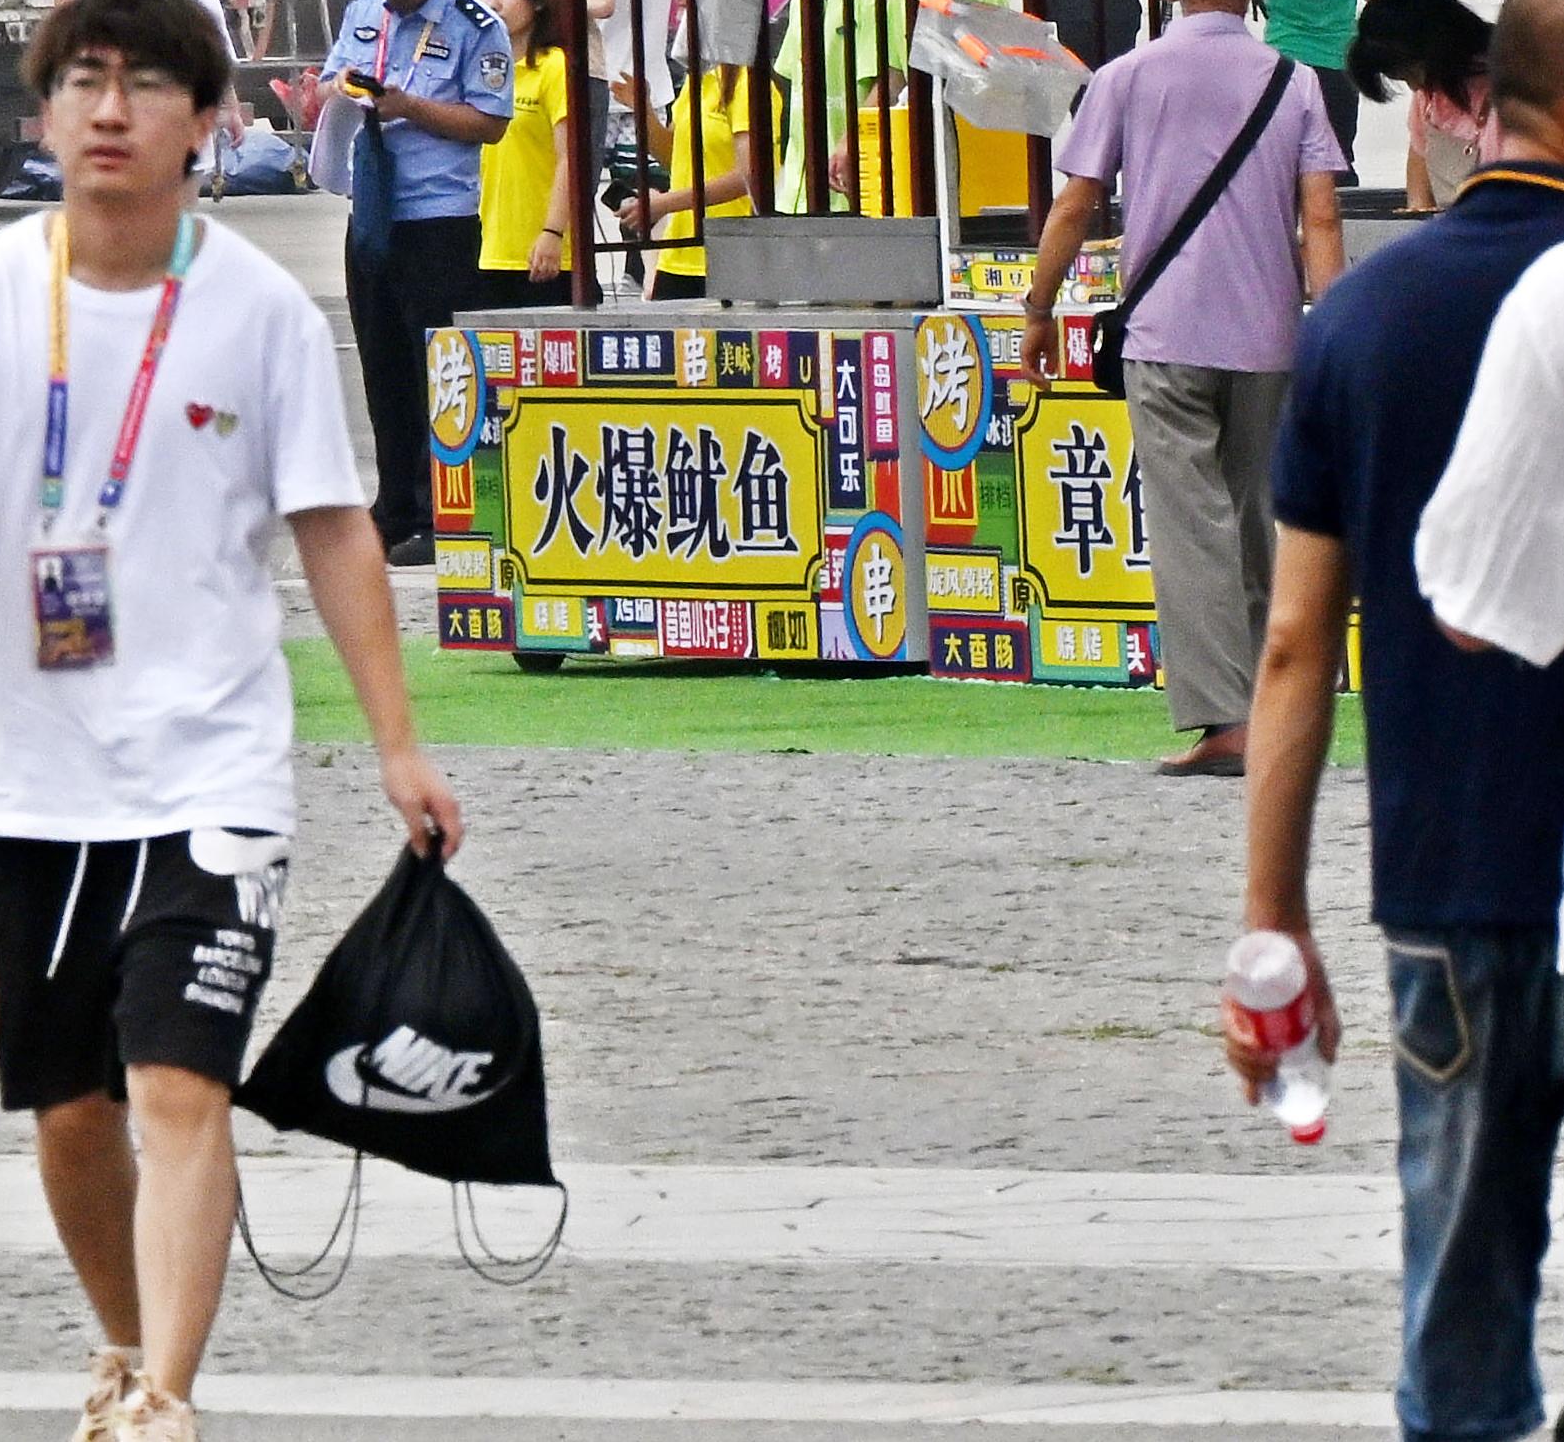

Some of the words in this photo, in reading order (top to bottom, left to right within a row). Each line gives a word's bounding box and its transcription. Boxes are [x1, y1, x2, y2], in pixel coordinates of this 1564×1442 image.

[602, 335, 661, 369] 酸辣粉
[683, 329, 708, 387] 串
[720, 341, 751, 376] 美味
[766, 344, 782, 380] 烤
[922, 322, 975, 432] 烤
[429, 337, 472, 434] 烤
[873, 336, 893, 443] 青岛鱿鱼
[836, 359, 860, 492] 大可乐
[531, 422, 800, 561] 火爆鱿鱼
[448, 609, 503, 640] 大香肠
[863, 543, 896, 643] 串
[768, 610, 808, 650] 椰奶
[944, 632, 1014, 669] 大香肠
[372, 1025, 495, 1100] NIKE
